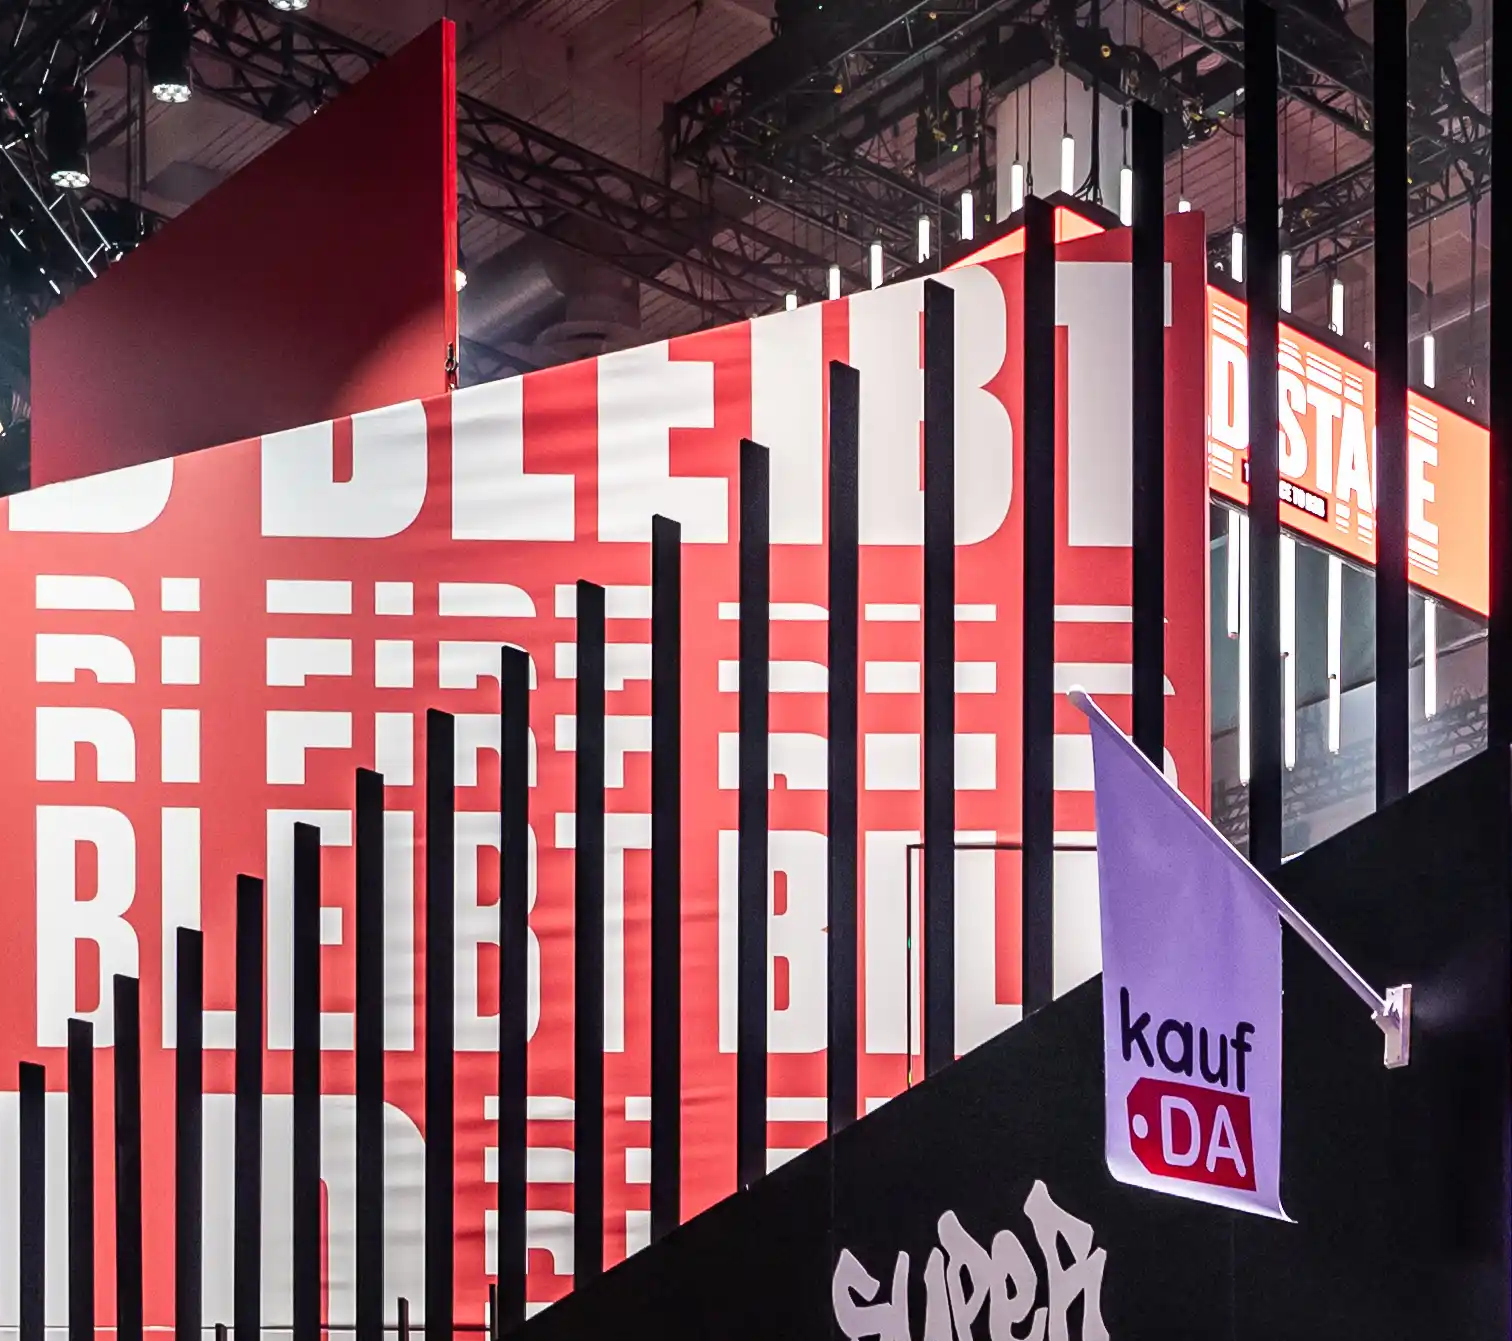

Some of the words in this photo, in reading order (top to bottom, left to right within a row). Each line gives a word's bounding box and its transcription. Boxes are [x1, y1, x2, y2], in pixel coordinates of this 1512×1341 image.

[1277, 364, 1439, 546] STAE
[719, 830, 1101, 1056] BIL
[1120, 987, 1255, 1093] kauf
